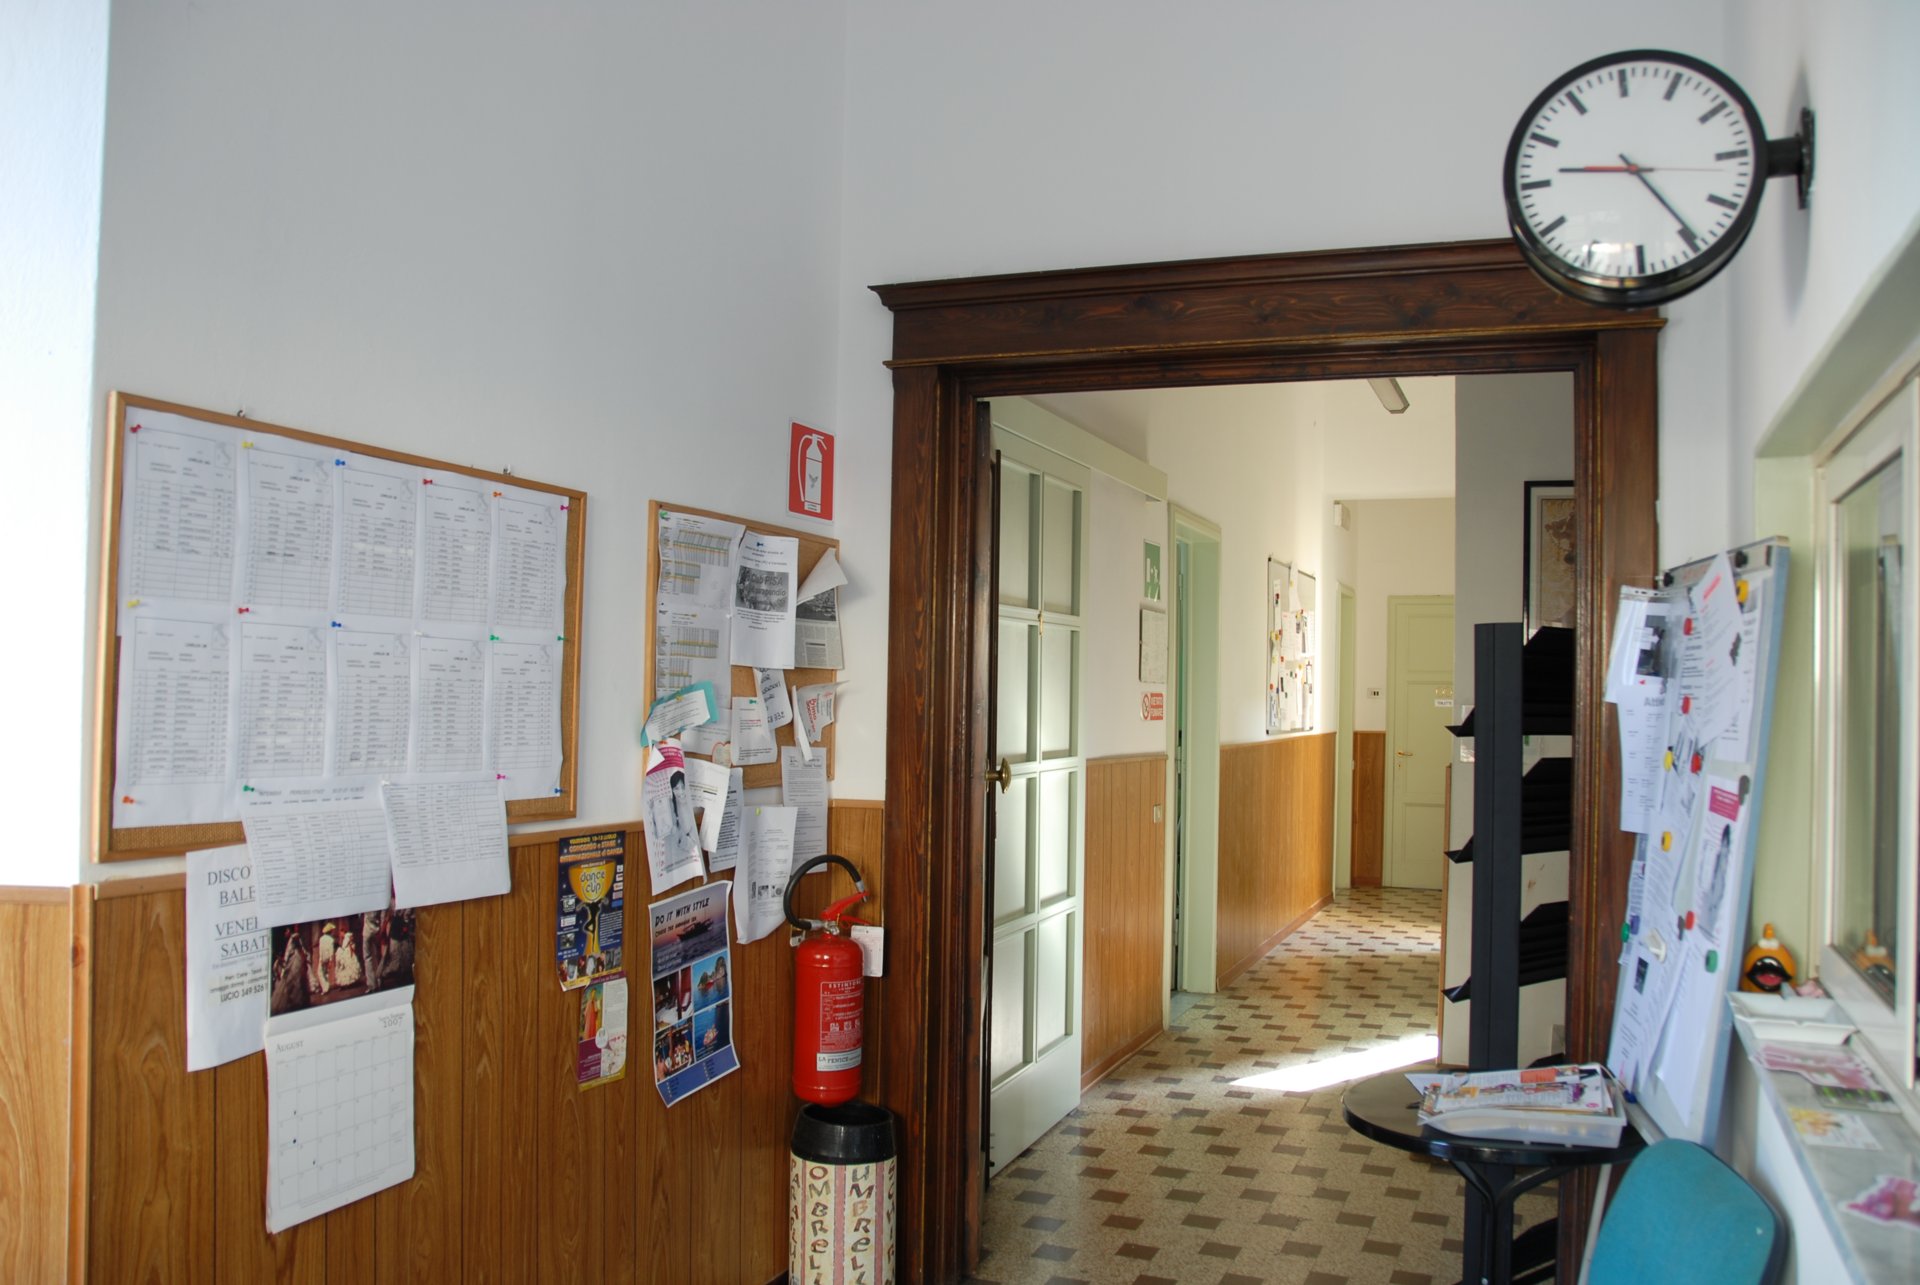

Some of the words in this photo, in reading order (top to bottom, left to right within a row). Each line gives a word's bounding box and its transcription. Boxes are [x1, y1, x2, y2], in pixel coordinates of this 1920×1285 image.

[207, 865, 252, 886] DISCO
[581, 870, 605, 882] dance
[586, 882, 601, 894] cup
[655, 914, 665, 927] DO
[666, 910, 673, 922] IT
[676, 904, 692, 918] WITH
[692, 897, 710, 911] STYLE
[215, 916, 259, 938] VENE
[276, 1040, 304, 1053] AUGUST
